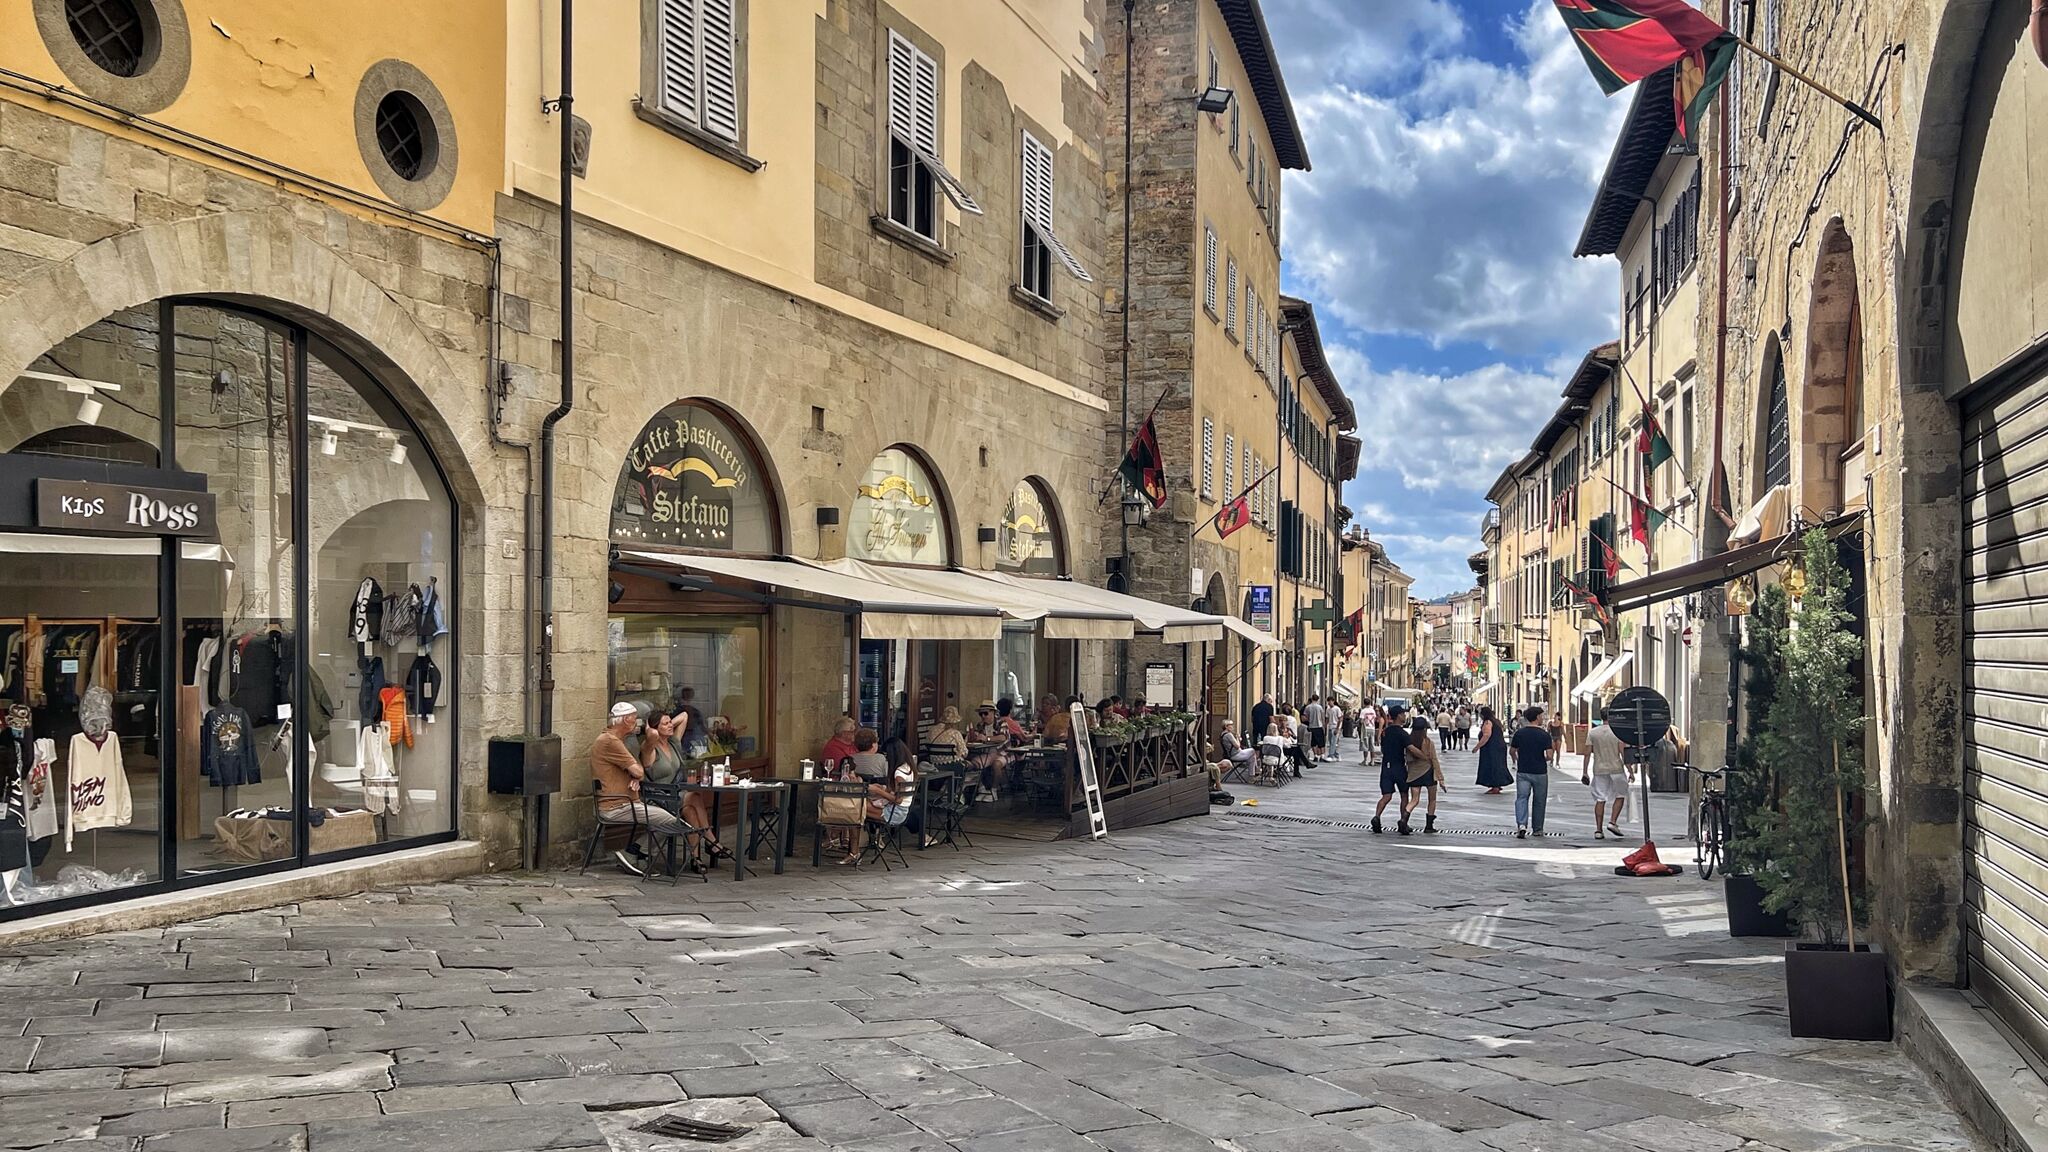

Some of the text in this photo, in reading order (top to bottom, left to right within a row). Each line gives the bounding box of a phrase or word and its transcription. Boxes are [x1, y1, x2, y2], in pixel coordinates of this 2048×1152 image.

[675, 420, 747, 487] Pasticceria
[61, 495, 105, 517] KIDS
[651, 490, 729, 527] Stefano
